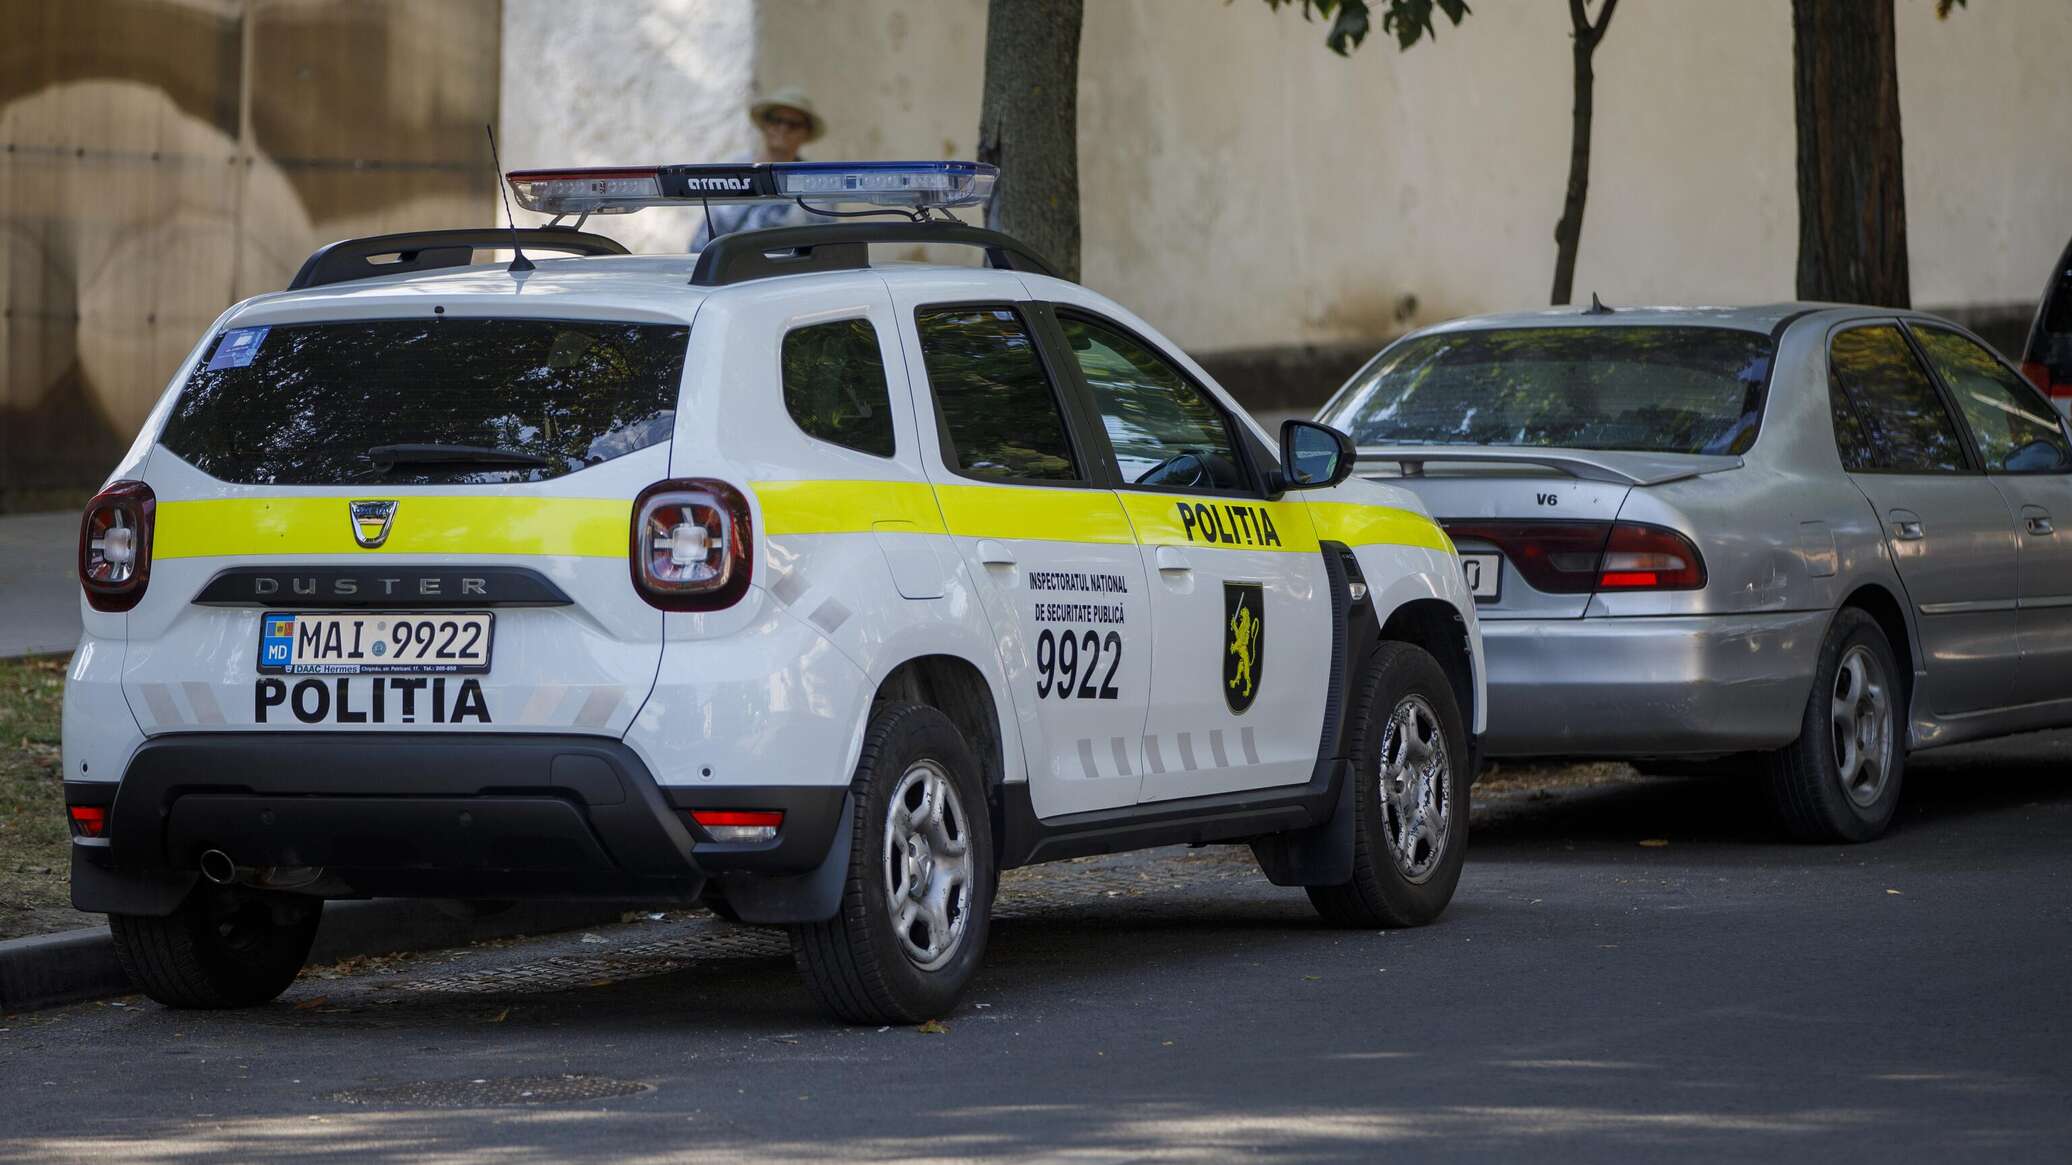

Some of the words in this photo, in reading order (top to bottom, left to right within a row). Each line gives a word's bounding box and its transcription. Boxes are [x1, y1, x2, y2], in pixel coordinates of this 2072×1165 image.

[688, 178, 751, 190] armas
[1536, 493, 1558, 506] V6
[255, 577, 487, 595] DUSTER
[1029, 572, 1090, 592] INSPECTORATUL
[1035, 603, 1045, 621] DE
[1047, 603, 1092, 623] SECURITATE
[1093, 602, 1125, 624] PUBLICĂ
[297, 621, 365, 659] MAI
[392, 621, 482, 659] 9922
[268, 645, 288, 660] MD
[296, 664, 320, 673] DAAC
[323, 664, 358, 673] Hermes
[1036, 628, 1122, 699] 9922
